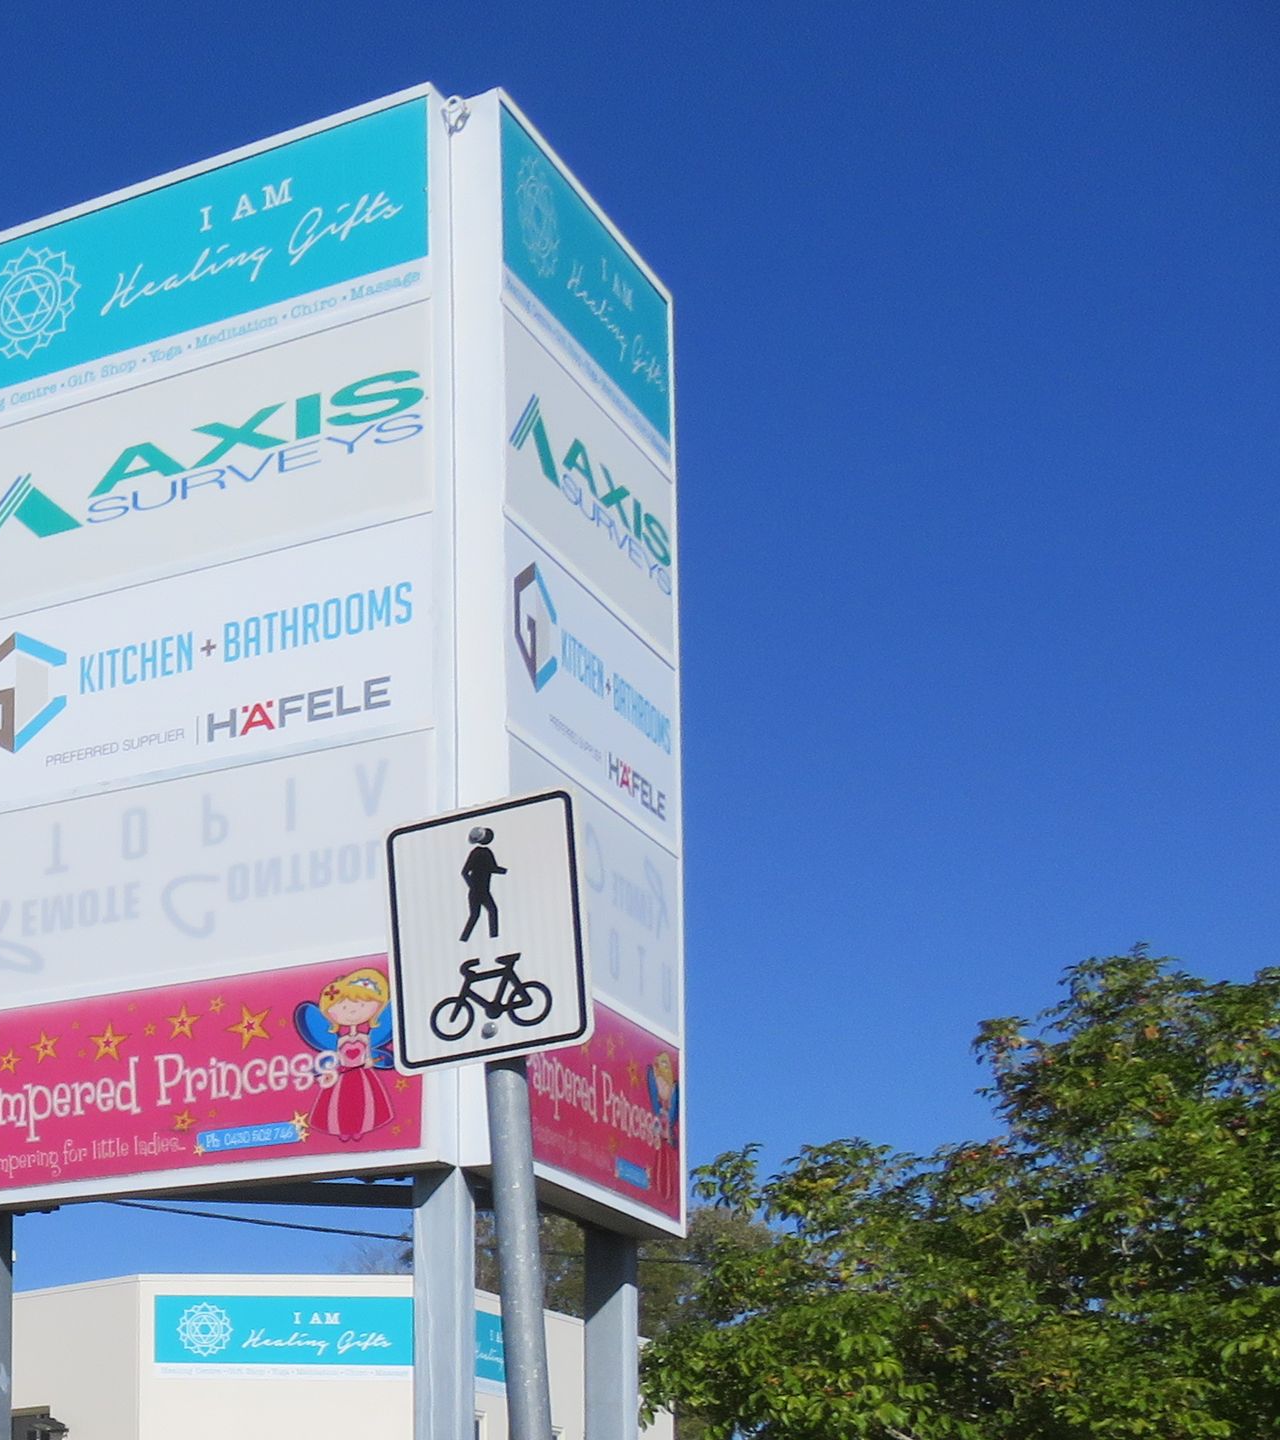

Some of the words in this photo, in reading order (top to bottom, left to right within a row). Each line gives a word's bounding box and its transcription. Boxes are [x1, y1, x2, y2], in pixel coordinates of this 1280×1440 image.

[100, 243, 273, 317] Healing
[288, 190, 404, 267] Gifts
[200, 206, 213, 233] I
[231, 177, 293, 222] AM
[10, 383, 58, 406] Centre
[67, 370, 97, 389] Gift
[100, 357, 138, 379] Shop
[148, 343, 183, 364] Yoga
[194, 312, 279, 349] Meditation
[289, 296, 338, 320] Chiro
[349, 269, 422, 302] Massage
[86, 413, 425, 524] SURVEYS
[87, 368, 426, 499] AXIS
[558, 471, 674, 597] SURVEYS
[561, 438, 673, 568] AXIS
[78, 630, 194, 695] KITCHEN
[222, 580, 414, 663] BATHROOMS
[45, 742, 120, 768] PREFERRED
[122, 727, 186, 752] SUPPLIER
[206, 675, 393, 743] HÄFELE
[560, 627, 604, 700] KITCHEN
[612, 671, 672, 756] BATHROOMS
[608, 751, 667, 822] HÄFELE
[154, 1050, 341, 1108] Princess
[600, 1070, 662, 1150] Princess
[63, 1138, 88, 1165] for
[91, 1134, 130, 1161] little
[241, 1328, 330, 1356] Healing
[336, 1330, 393, 1355] Gifts
[309, 1311, 342, 1326] AM
